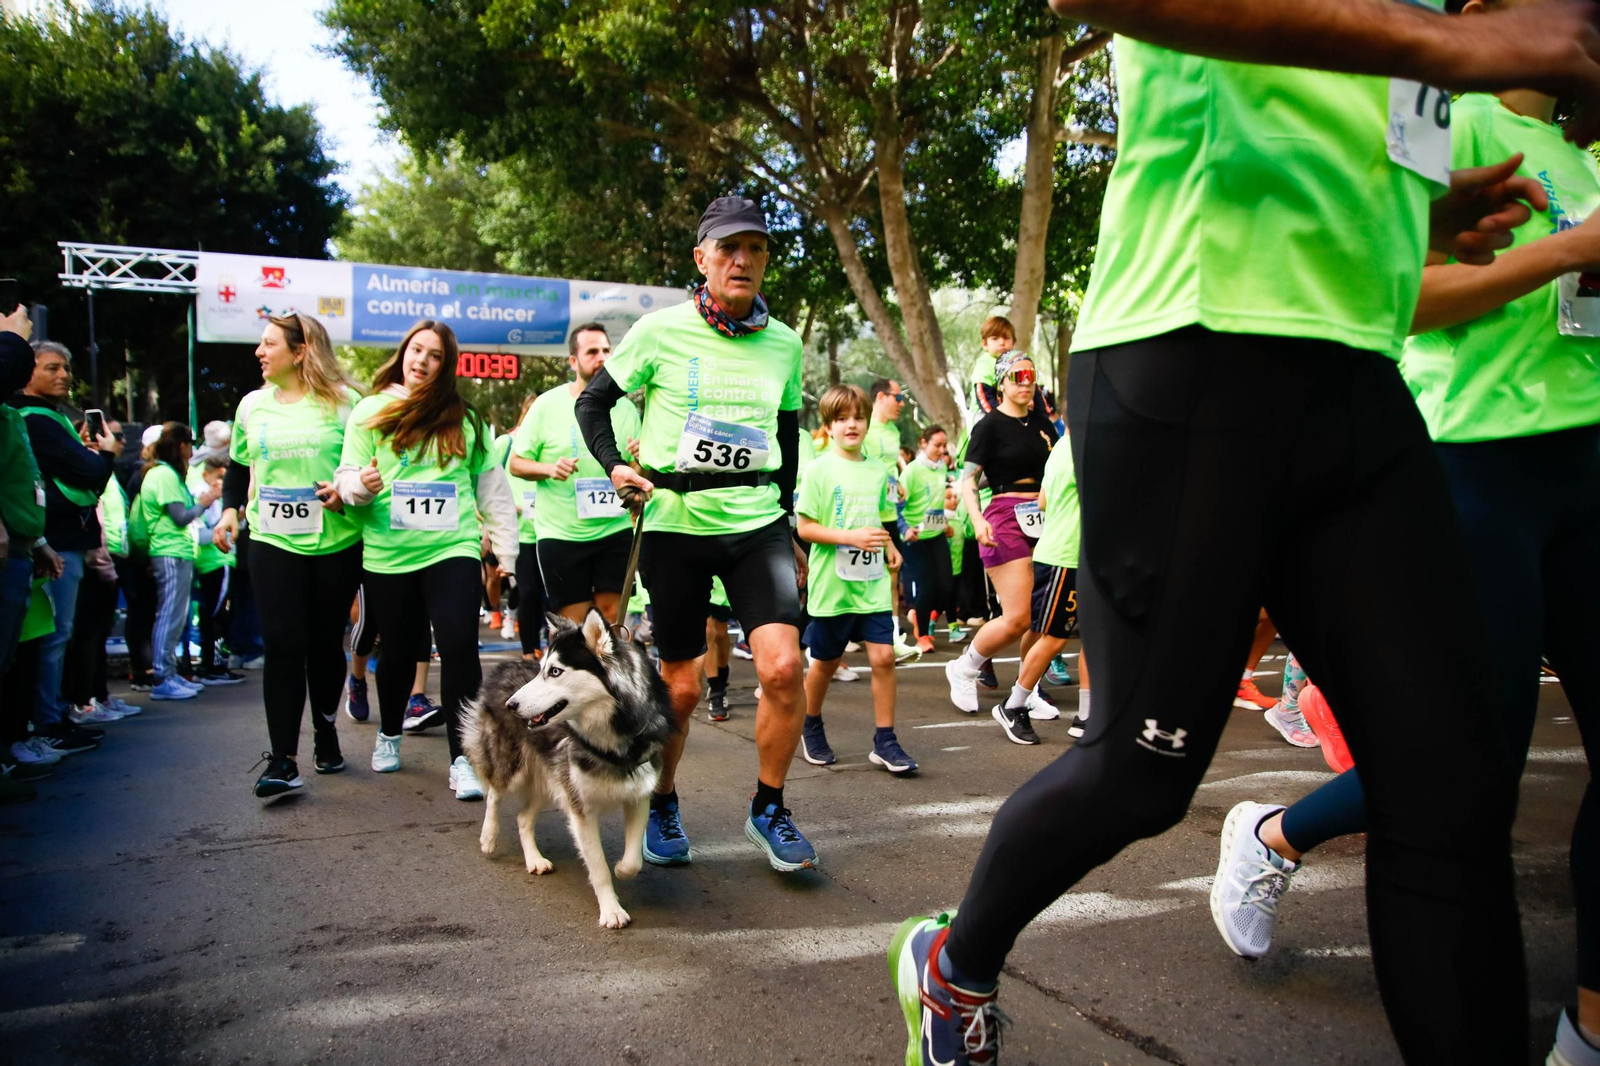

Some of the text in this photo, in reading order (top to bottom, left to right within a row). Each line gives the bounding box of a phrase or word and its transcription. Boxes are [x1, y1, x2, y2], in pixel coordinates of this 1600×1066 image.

[367, 273, 559, 302] Almería en marcha
[367, 298, 436, 317] contra
[441, 300, 462, 318] el
[466, 302, 536, 322] cáncer
[703, 388, 774, 402] contra el
[703, 401, 772, 419] cáncer
[694, 439, 752, 470] 536
[587, 491, 616, 504] 127
[269, 503, 309, 518] 796
[406, 498, 446, 514] 117
[1026, 511, 1046, 527] 31
